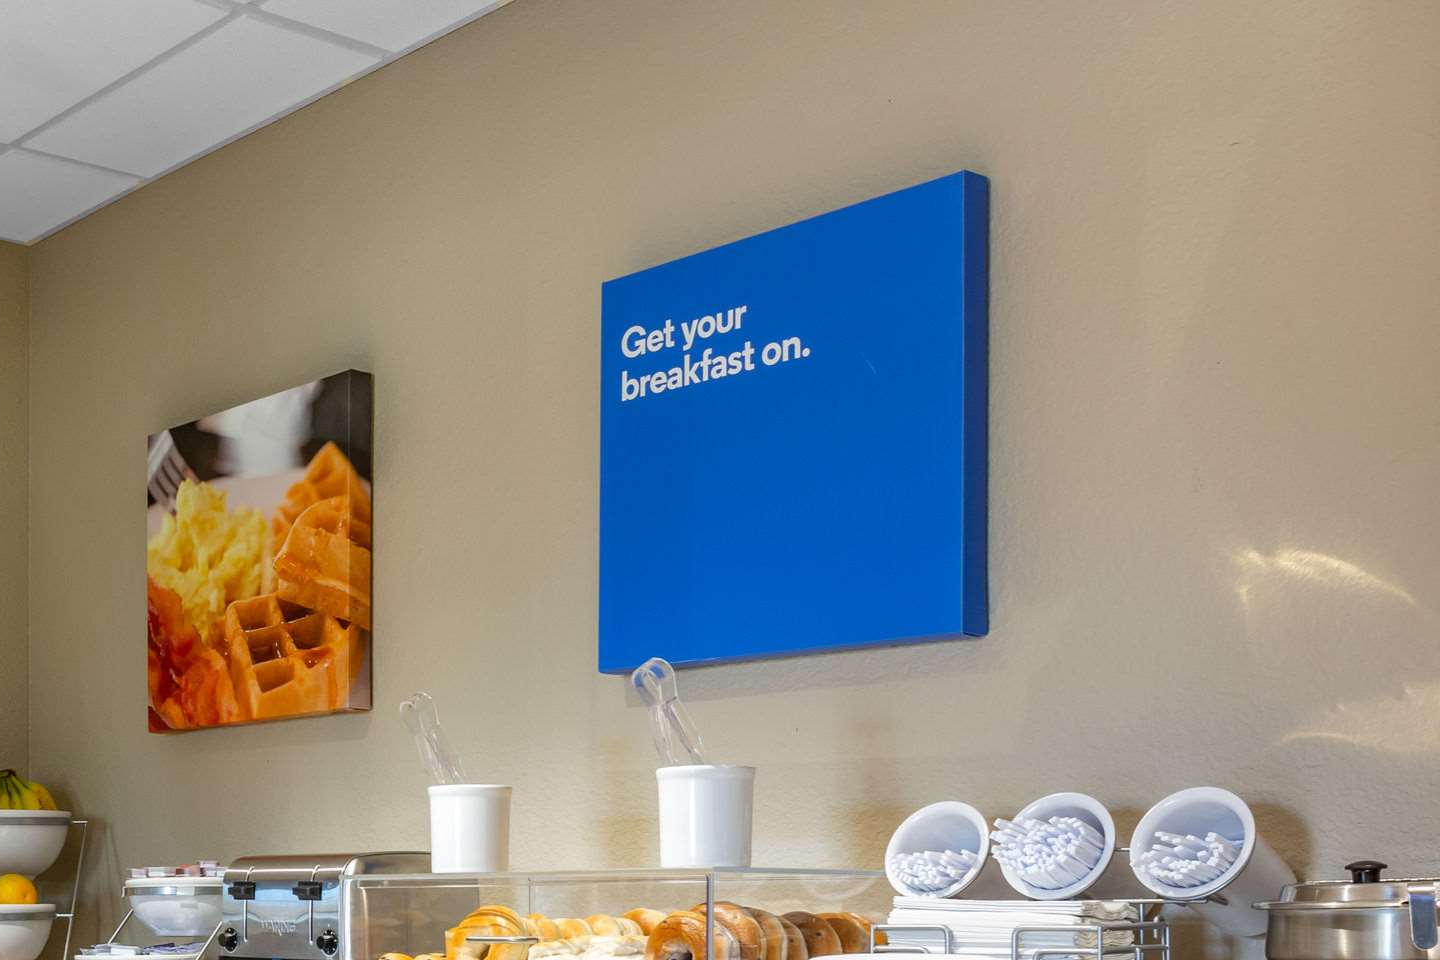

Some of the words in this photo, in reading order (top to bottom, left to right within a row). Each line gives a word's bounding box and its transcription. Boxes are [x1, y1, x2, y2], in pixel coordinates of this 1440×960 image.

[620, 319, 676, 359] Get
[681, 305, 747, 351] your
[620, 341, 756, 402] breakfast
[761, 336, 811, 366] on.
